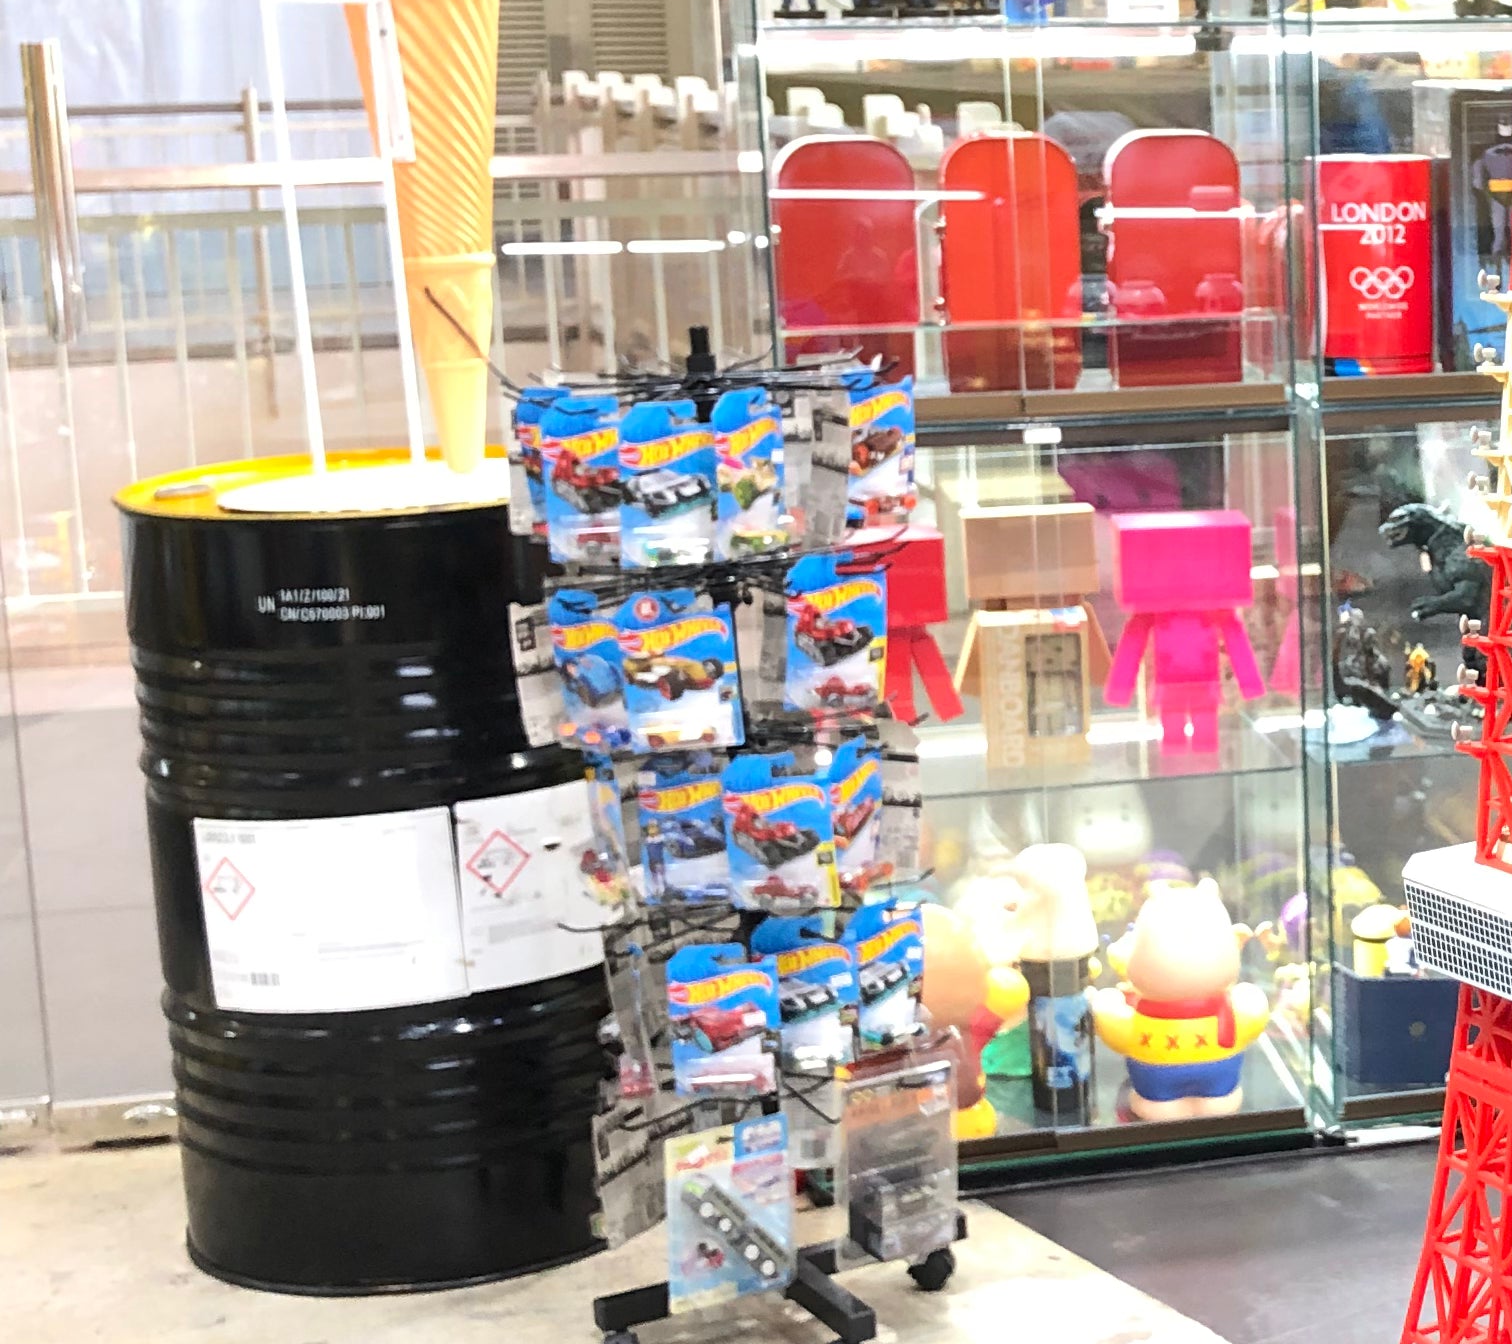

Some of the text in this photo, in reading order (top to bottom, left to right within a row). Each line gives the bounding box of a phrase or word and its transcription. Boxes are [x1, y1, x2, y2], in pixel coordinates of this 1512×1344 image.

[1330, 201, 1427, 224] LONDON
[1359, 223, 1407, 245] 2012
[257, 595, 276, 614] UN
